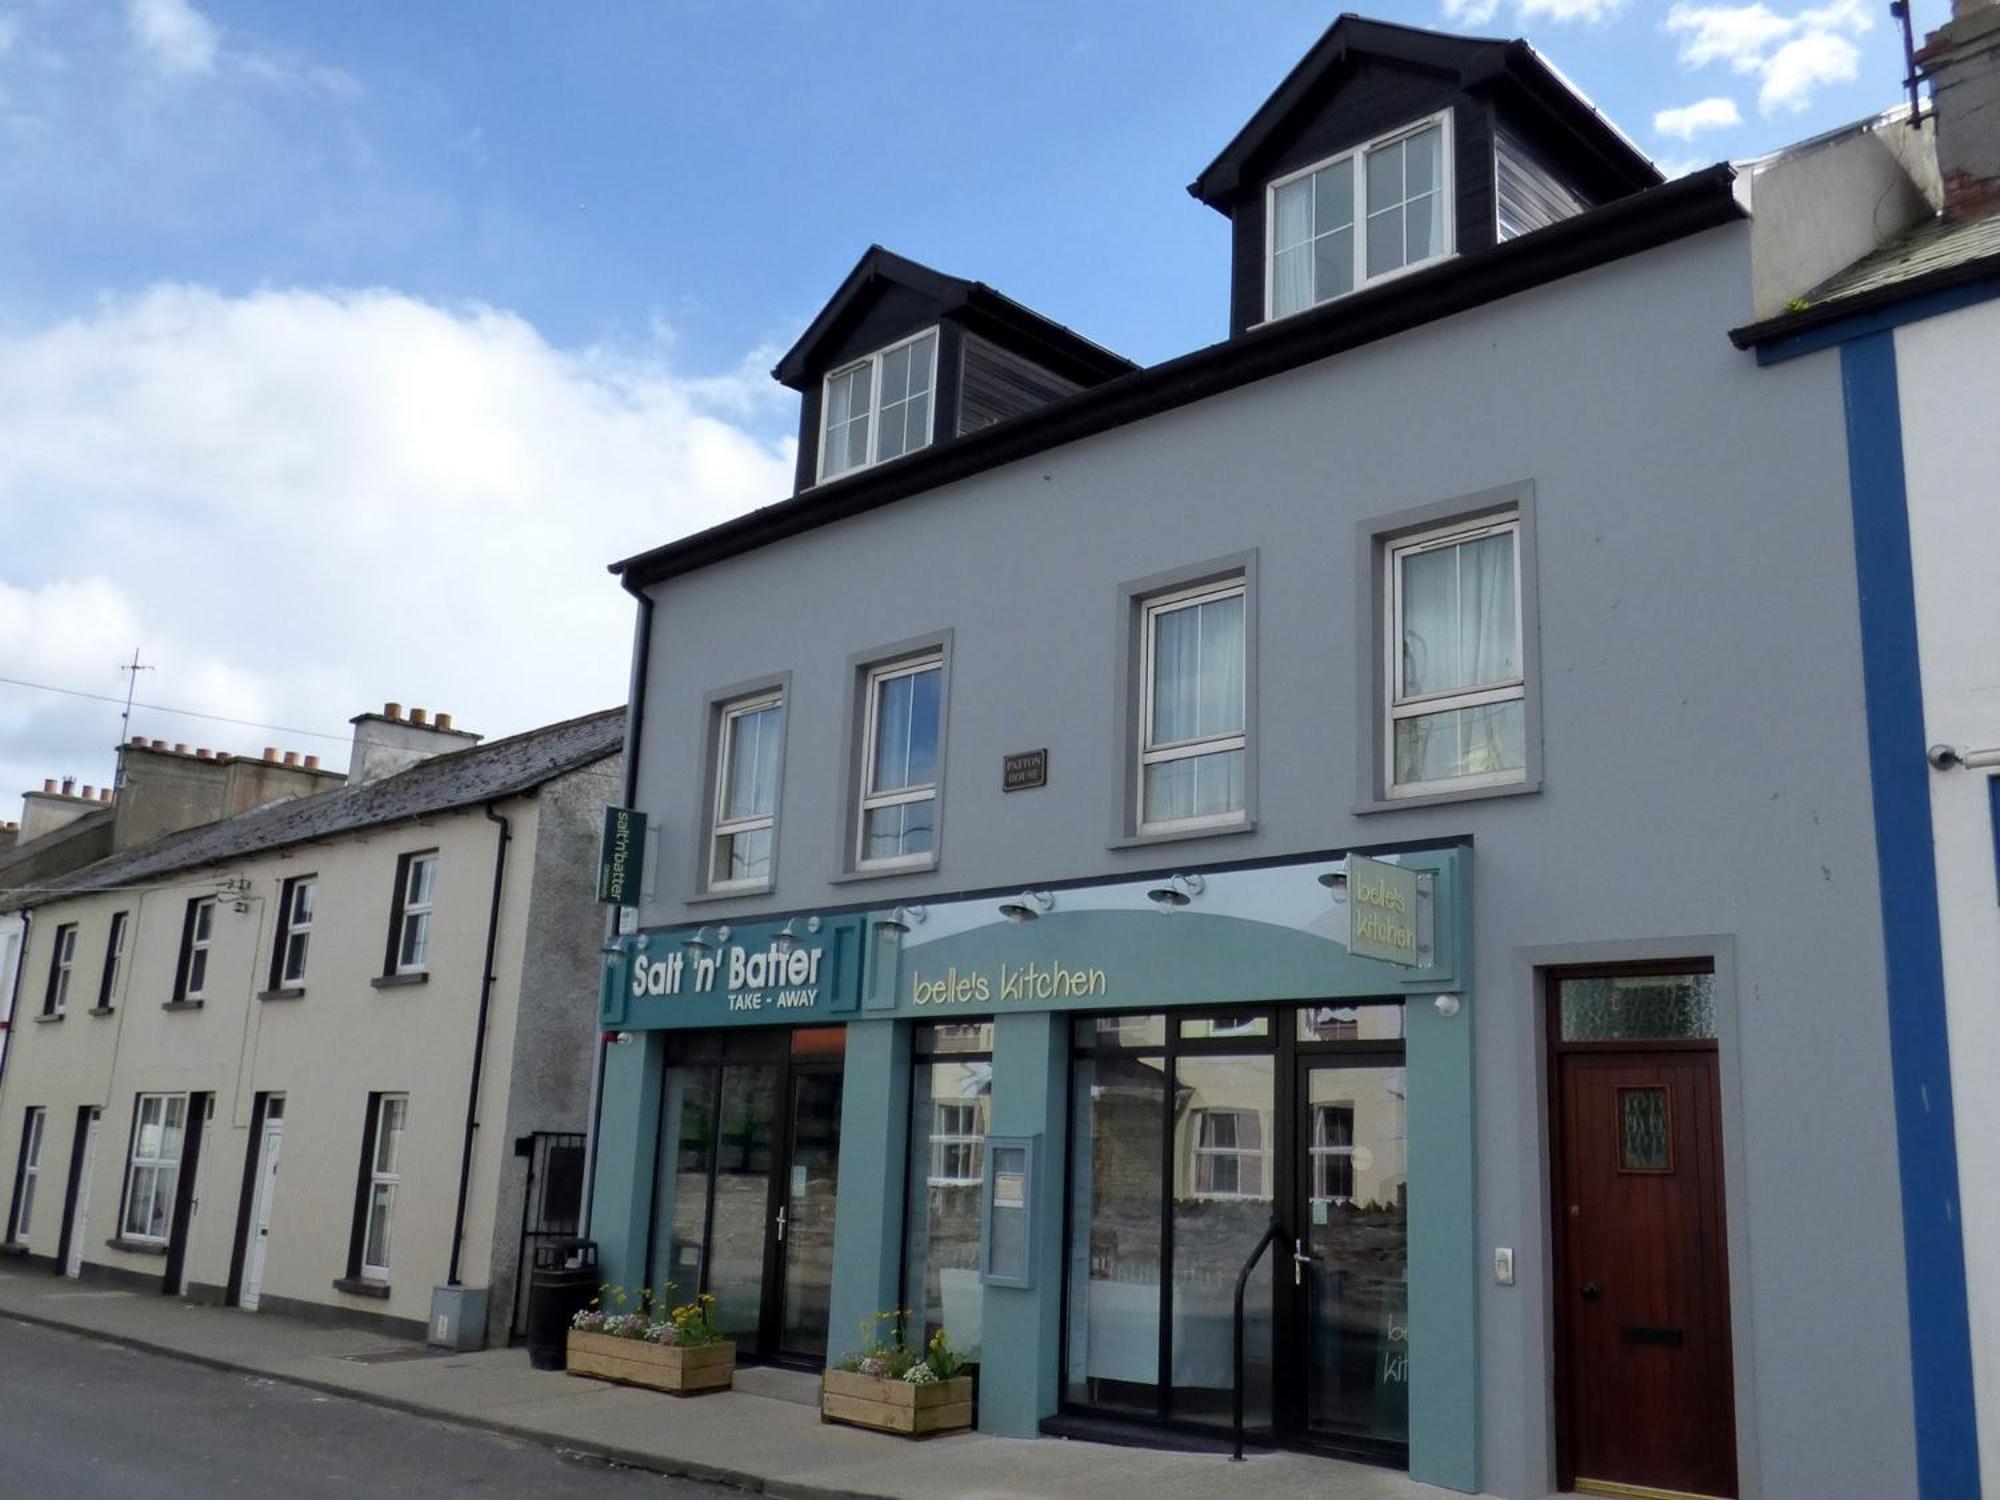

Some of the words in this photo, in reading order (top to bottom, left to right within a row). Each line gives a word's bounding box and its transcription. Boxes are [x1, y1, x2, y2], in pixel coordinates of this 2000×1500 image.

[1356, 909, 1415, 949] kitchen
[632, 952, 684, 997] Salt
[728, 943, 822, 990] Batter
[913, 967, 990, 1005] belle's
[1000, 961, 1106, 1001] kitchen
[728, 993, 761, 1011] TAKE
[777, 990, 817, 1008] AWAY
